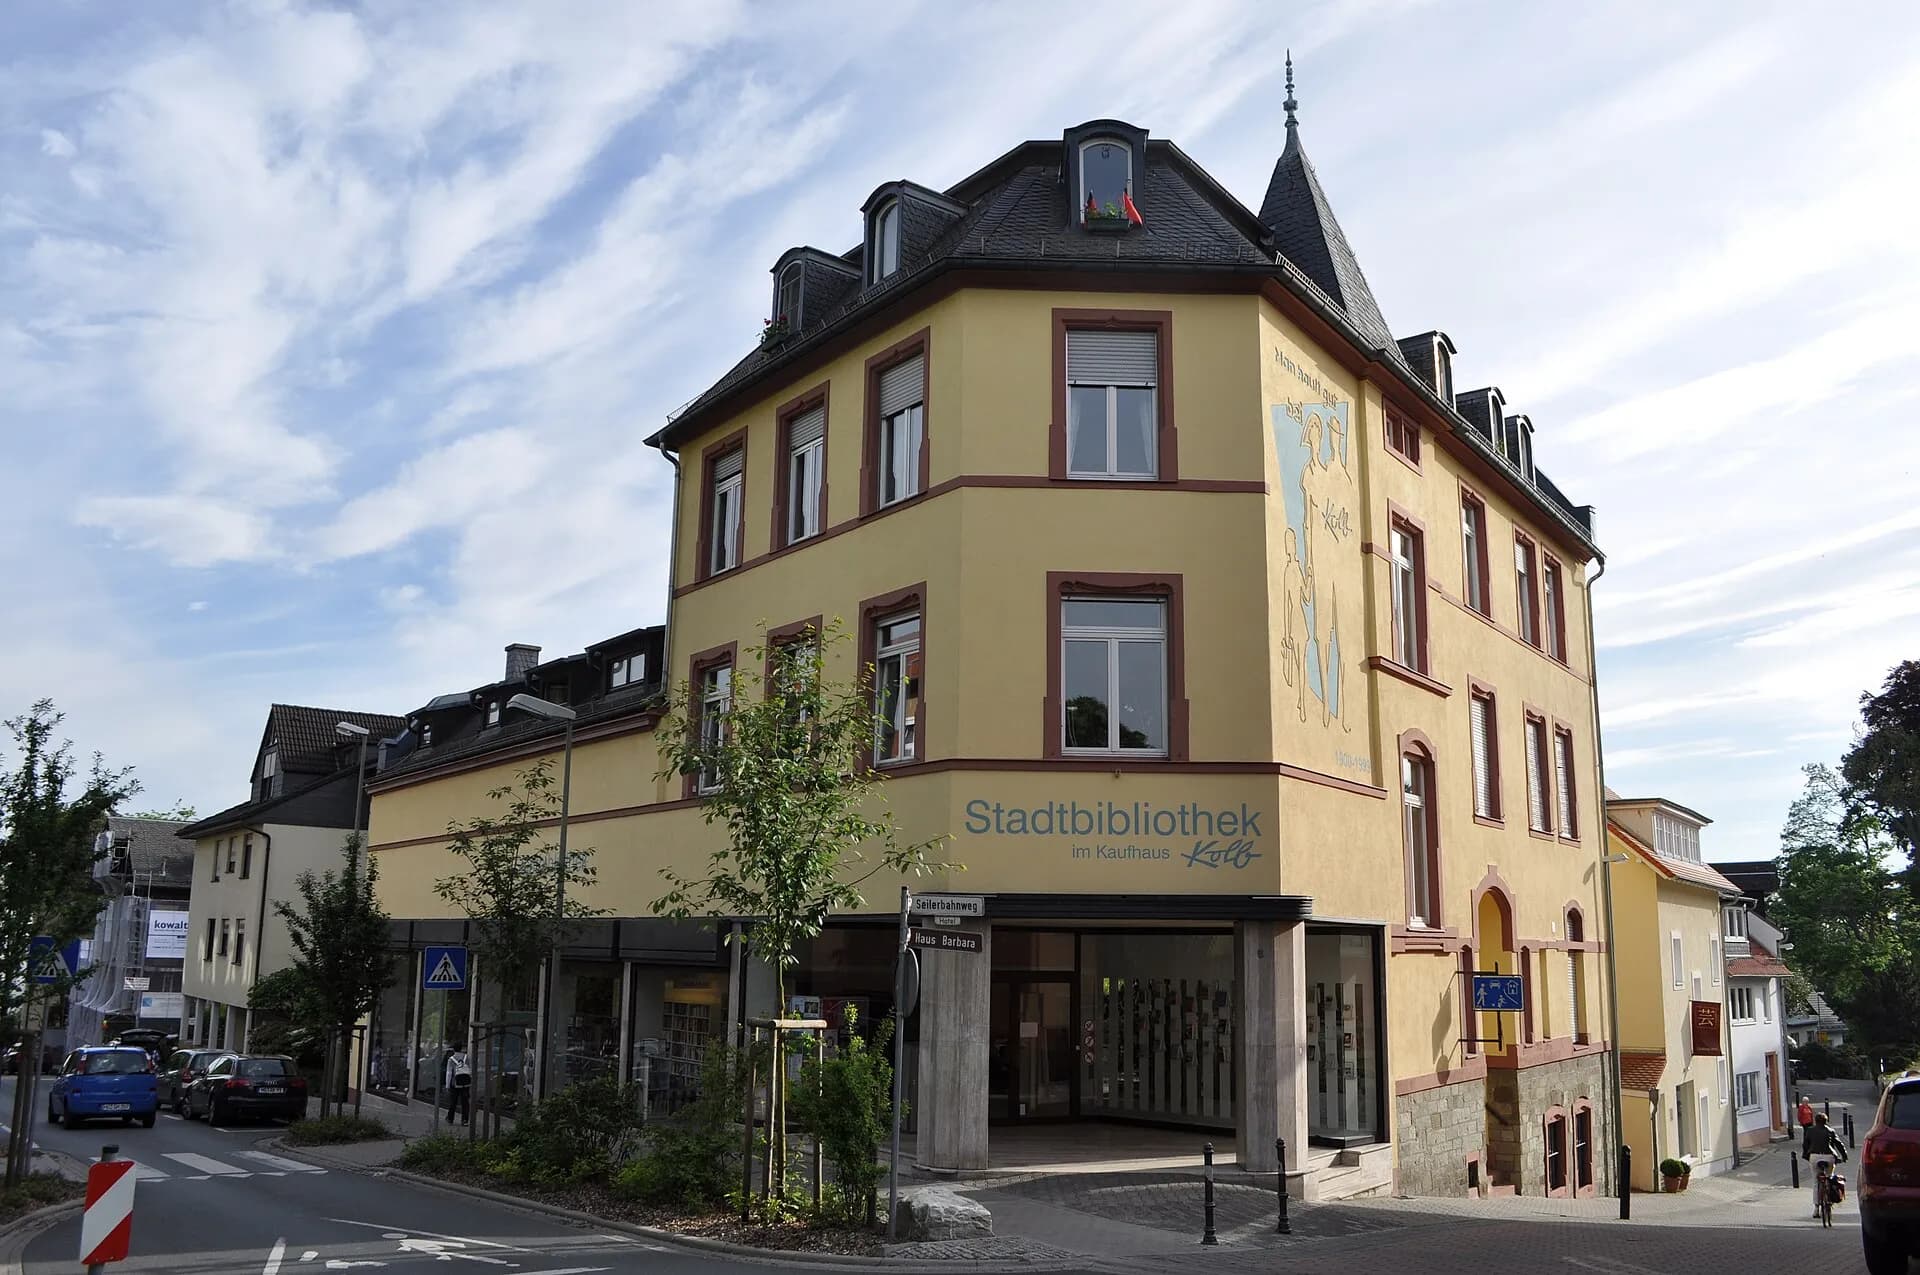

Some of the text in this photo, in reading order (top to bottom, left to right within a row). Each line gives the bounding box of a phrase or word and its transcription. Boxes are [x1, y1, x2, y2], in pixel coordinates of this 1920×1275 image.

[964, 799, 1262, 838] Stadtbibliothek
[1071, 838, 1263, 870] im Kaufhaus Kolb
[916, 899, 978, 913] Seilerbahnweg
[915, 932, 976, 949] Haus Barbara
